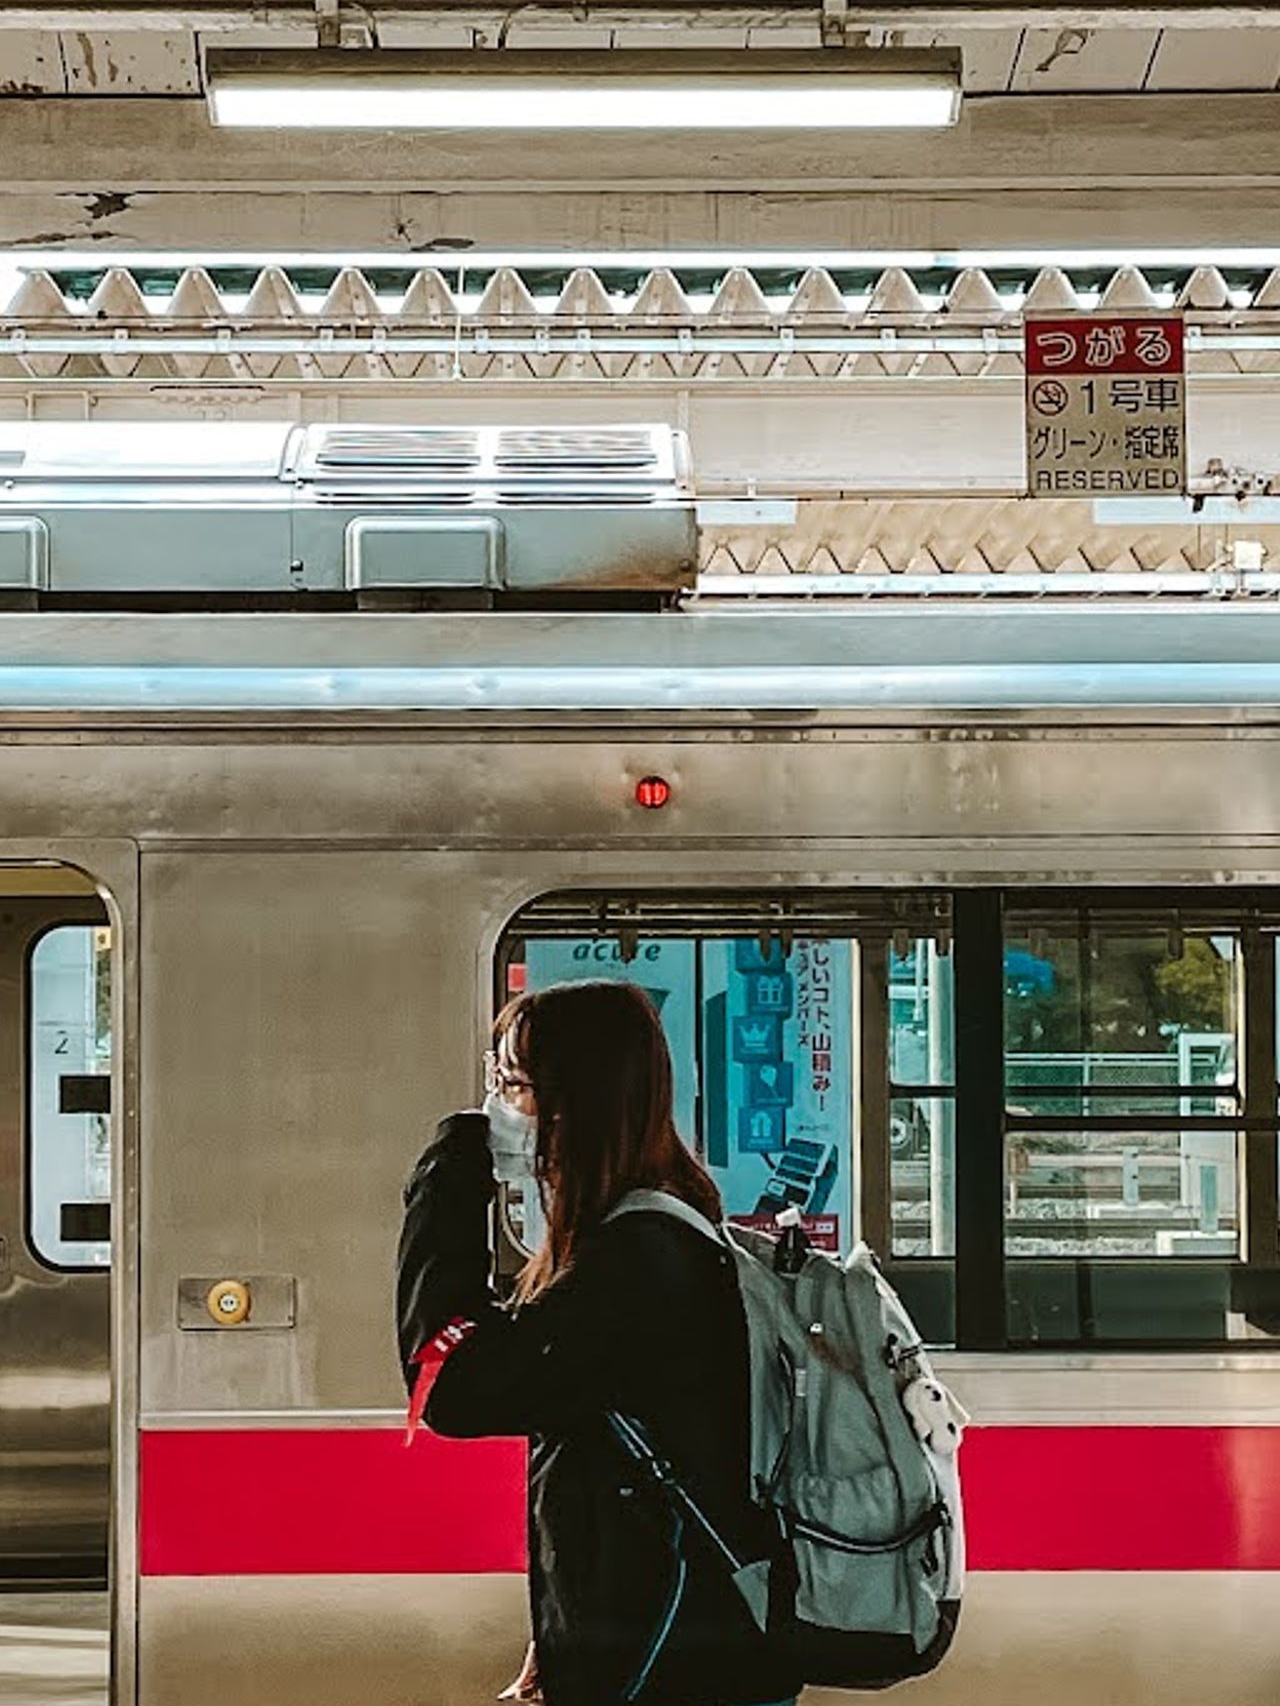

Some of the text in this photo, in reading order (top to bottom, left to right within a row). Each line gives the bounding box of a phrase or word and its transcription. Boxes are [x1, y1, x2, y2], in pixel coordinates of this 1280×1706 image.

[1036, 326, 1172, 367] つがる
[1036, 470, 1179, 490] RESERVED
[573, 943, 662, 962] ace
